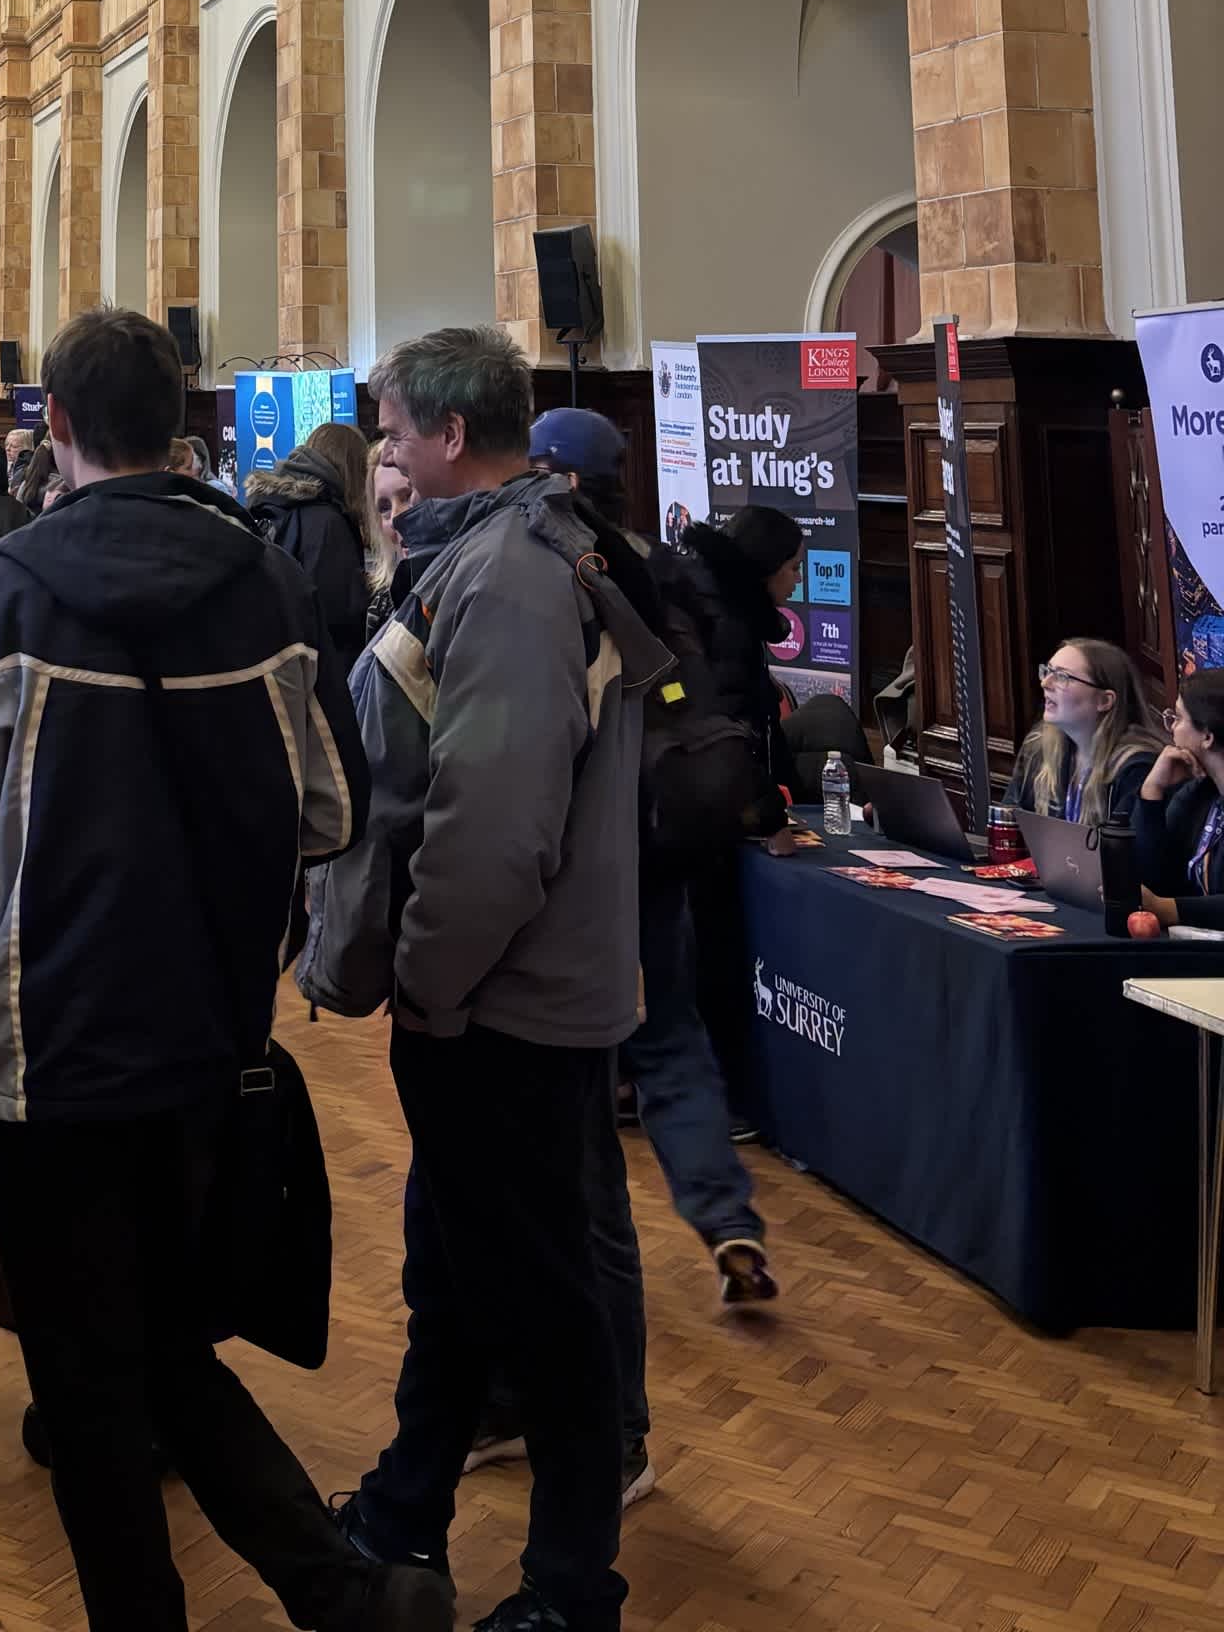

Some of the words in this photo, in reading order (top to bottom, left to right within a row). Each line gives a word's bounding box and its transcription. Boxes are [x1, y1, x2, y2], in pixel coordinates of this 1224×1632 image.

[808, 368, 849, 377] LONDON
[708, 405, 791, 449] Study
[1171, 404, 1224, 437] More
[712, 451, 743, 486] at
[751, 451, 835, 497] King's
[813, 561, 833, 580] Top
[834, 563, 845, 578] 10
[821, 622, 840, 639] 7th
[775, 974, 830, 1016] UNIVERSITY
[832, 1004, 847, 1024] OF
[776, 992, 845, 1056] SURREY
